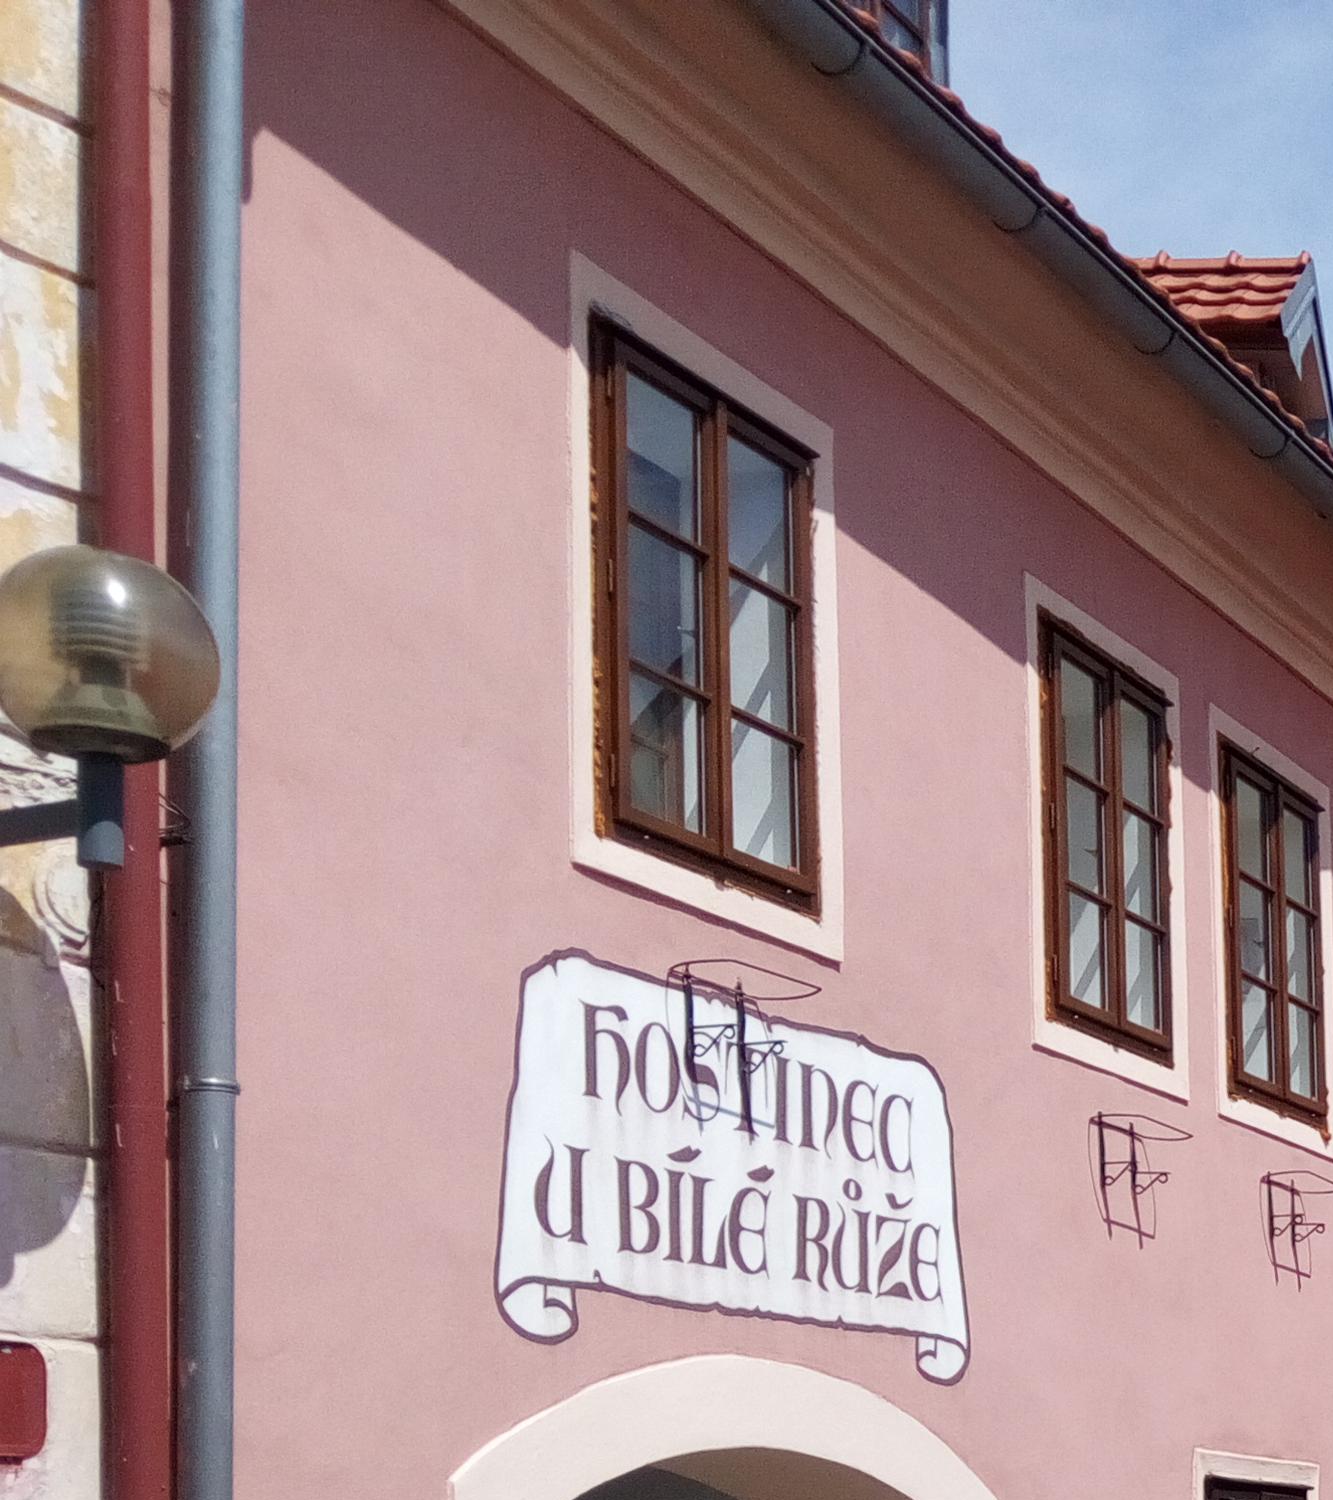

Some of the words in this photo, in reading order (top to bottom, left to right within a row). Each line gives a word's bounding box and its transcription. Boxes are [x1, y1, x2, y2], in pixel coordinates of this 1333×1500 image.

[534, 1135, 591, 1245] U
[614, 1146, 774, 1279] BÍLÉ
[791, 1179, 943, 1305] RŮŽE
